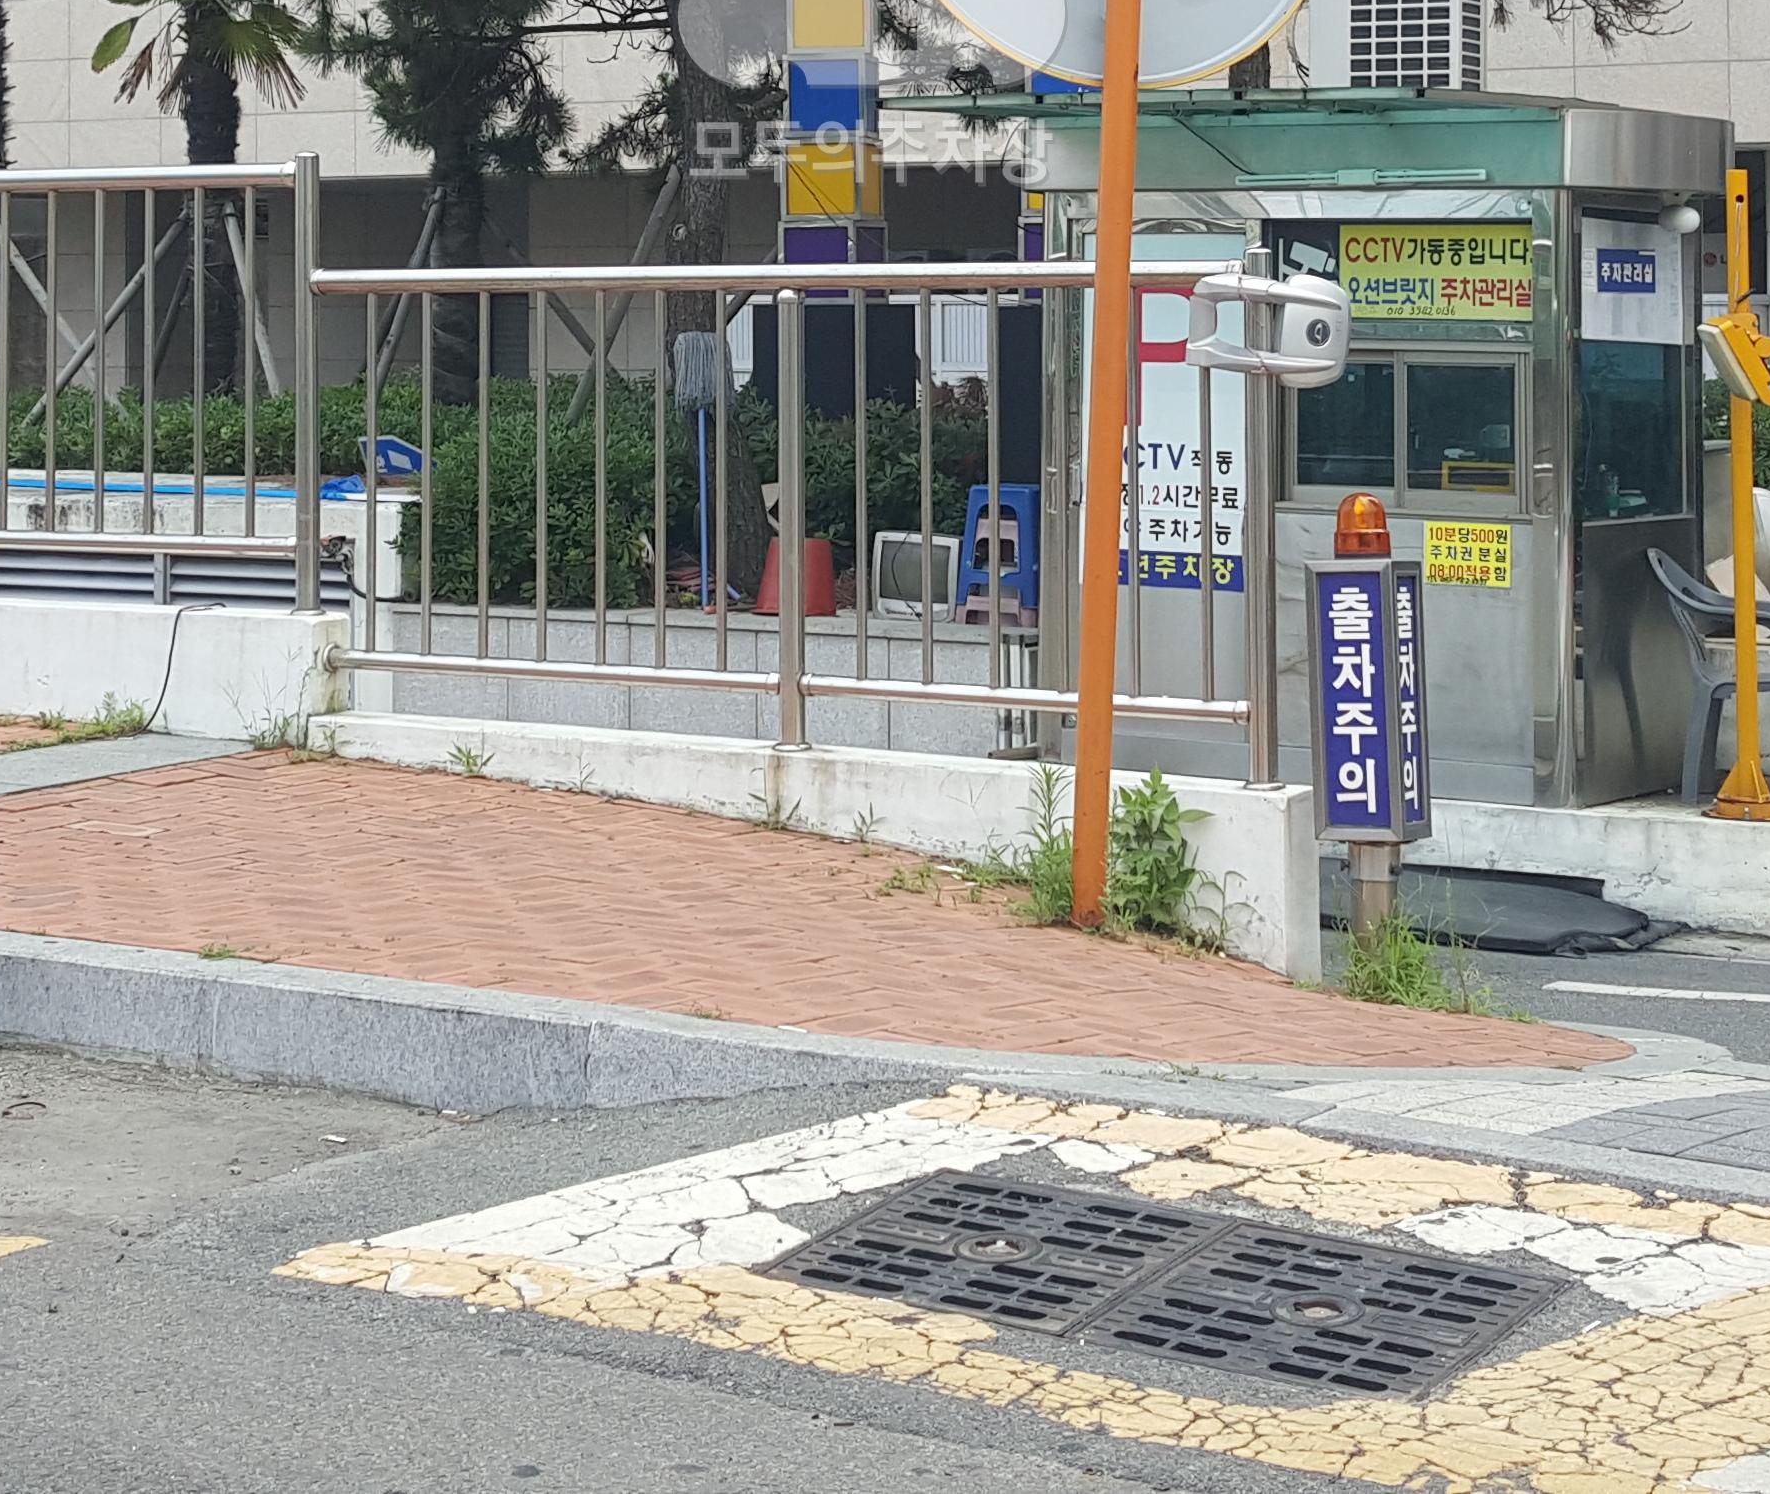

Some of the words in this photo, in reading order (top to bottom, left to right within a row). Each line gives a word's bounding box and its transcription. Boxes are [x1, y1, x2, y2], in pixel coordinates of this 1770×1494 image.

[1348, 276, 1435, 306] 오션브릿지
[1439, 277, 1533, 309] 주차관리실
[1123, 442, 1186, 471] CTV
[1328, 586, 1379, 814] 출차주의
[1396, 585, 1419, 811] 출차주의
